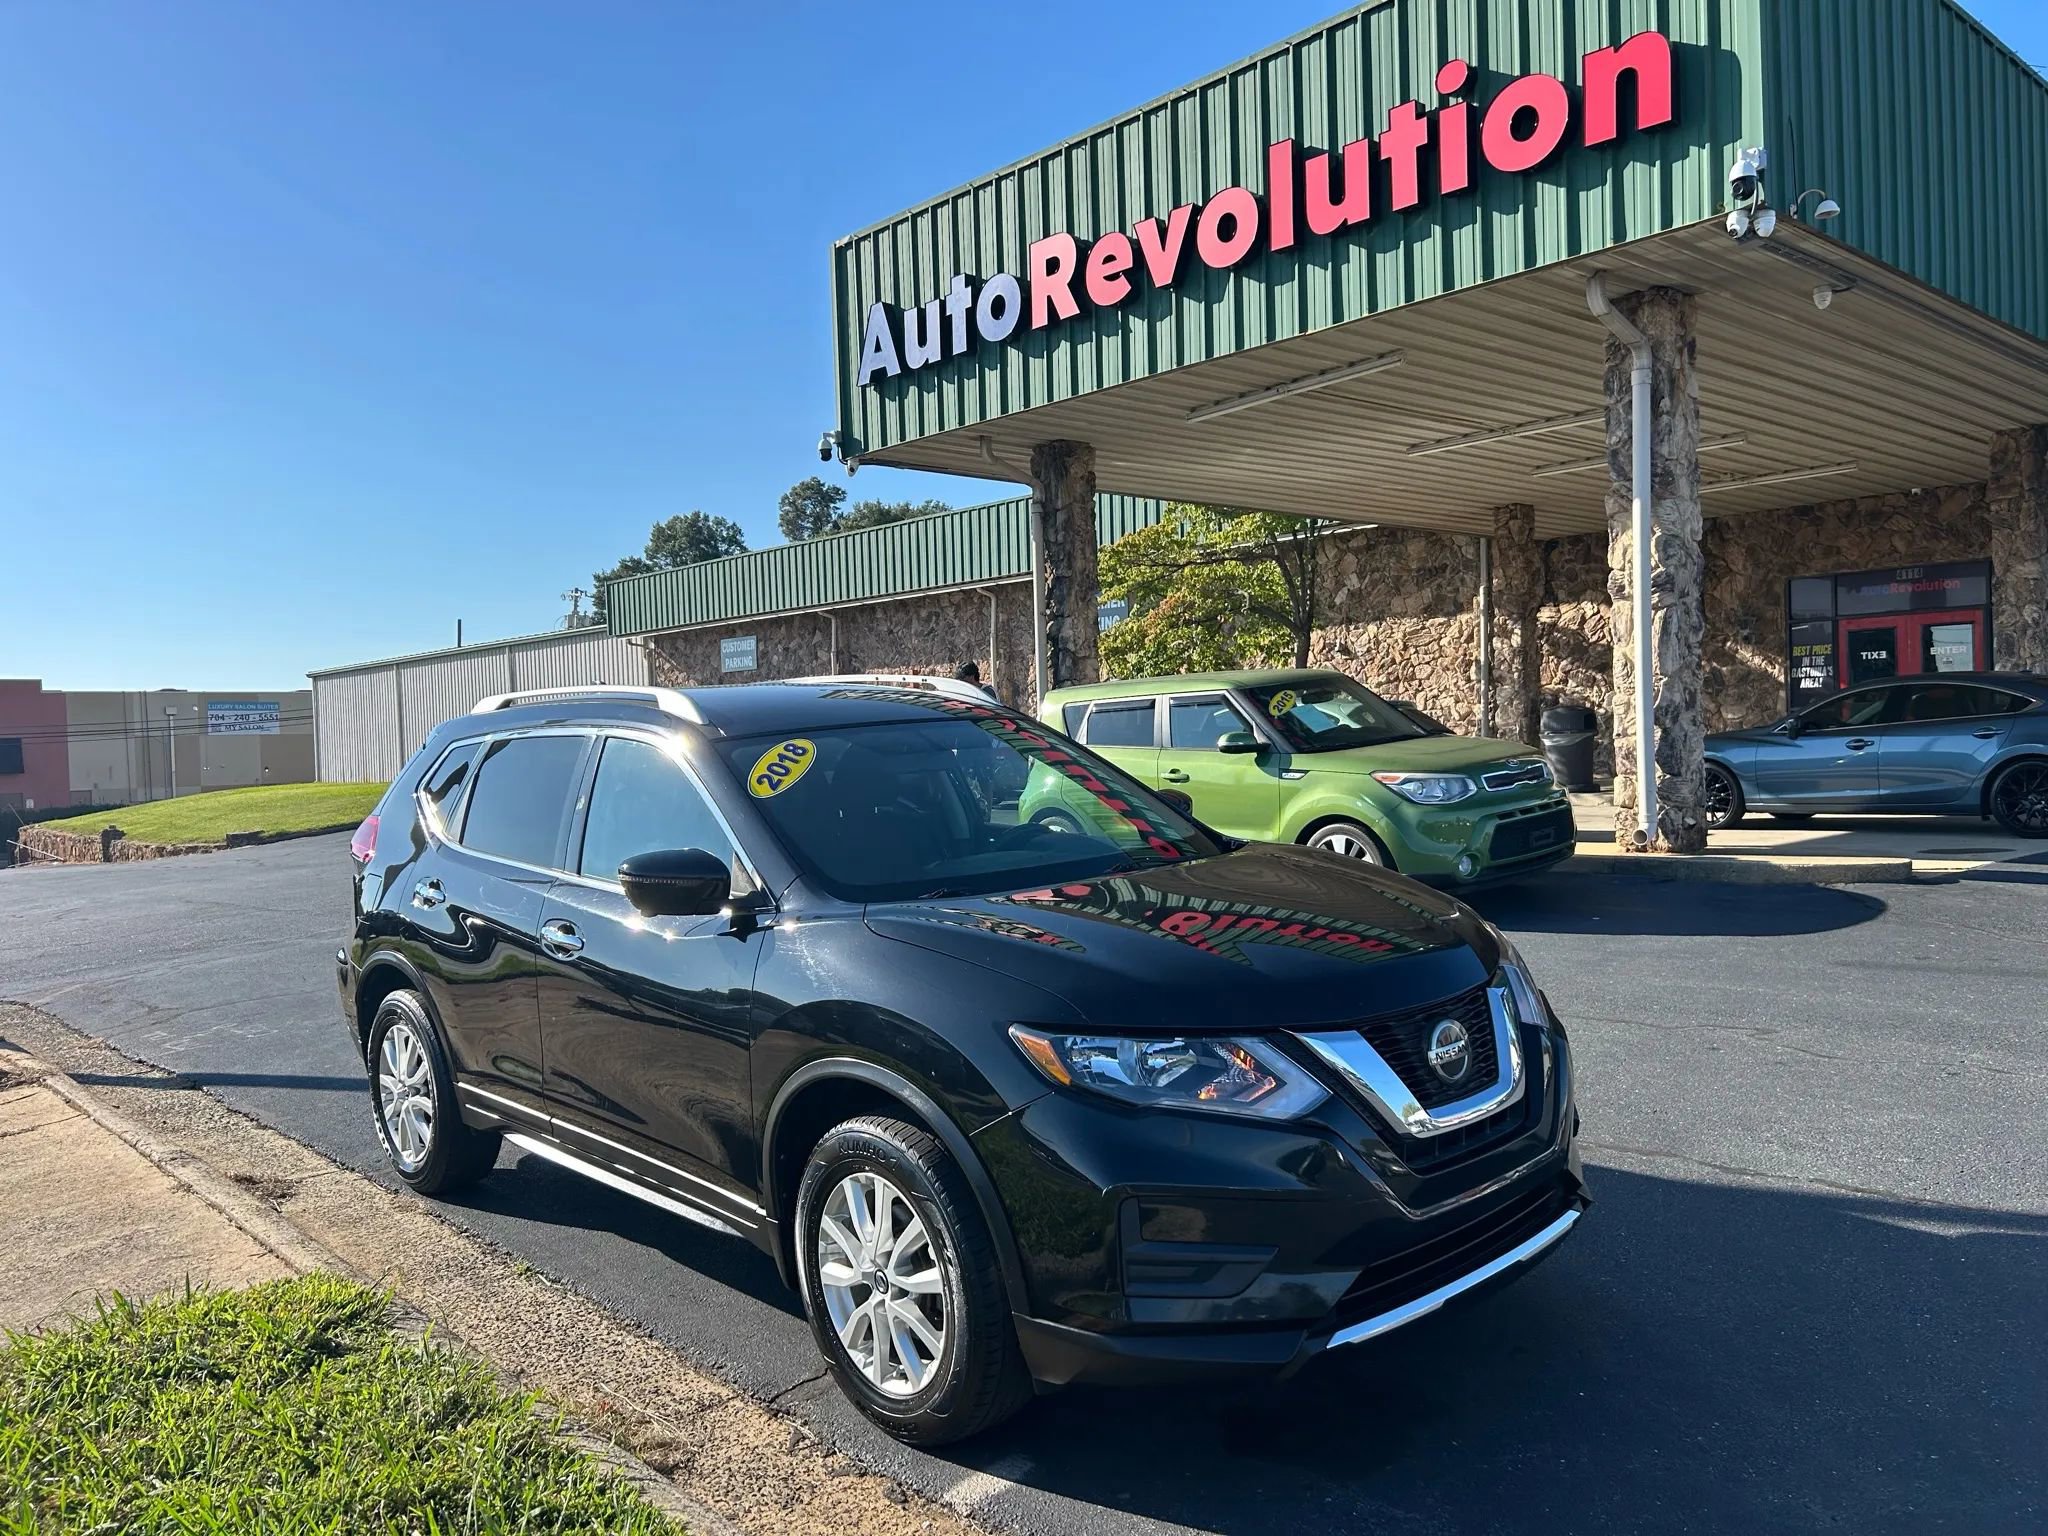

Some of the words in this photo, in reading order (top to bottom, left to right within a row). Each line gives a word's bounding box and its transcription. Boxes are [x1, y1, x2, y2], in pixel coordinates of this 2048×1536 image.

[857, 30, 1676, 387] AutoRevolution
[722, 639, 755, 653] CUSTOMER
[1792, 645, 1811, 656] BEST
[1812, 644, 1832, 655] PRICE
[1930, 645, 1968, 655] ENTER
[725, 656, 753, 668] PARKING
[1801, 656, 1810, 666] IN
[1811, 655, 1825, 666] THE
[1800, 677, 1824, 688] AREA!
[1272, 691, 1293, 713] 2015
[756, 743, 808, 791] 2018
[1435, 1043, 1468, 1061] NISSAN
[838, 1139, 887, 1163] KUMHO
